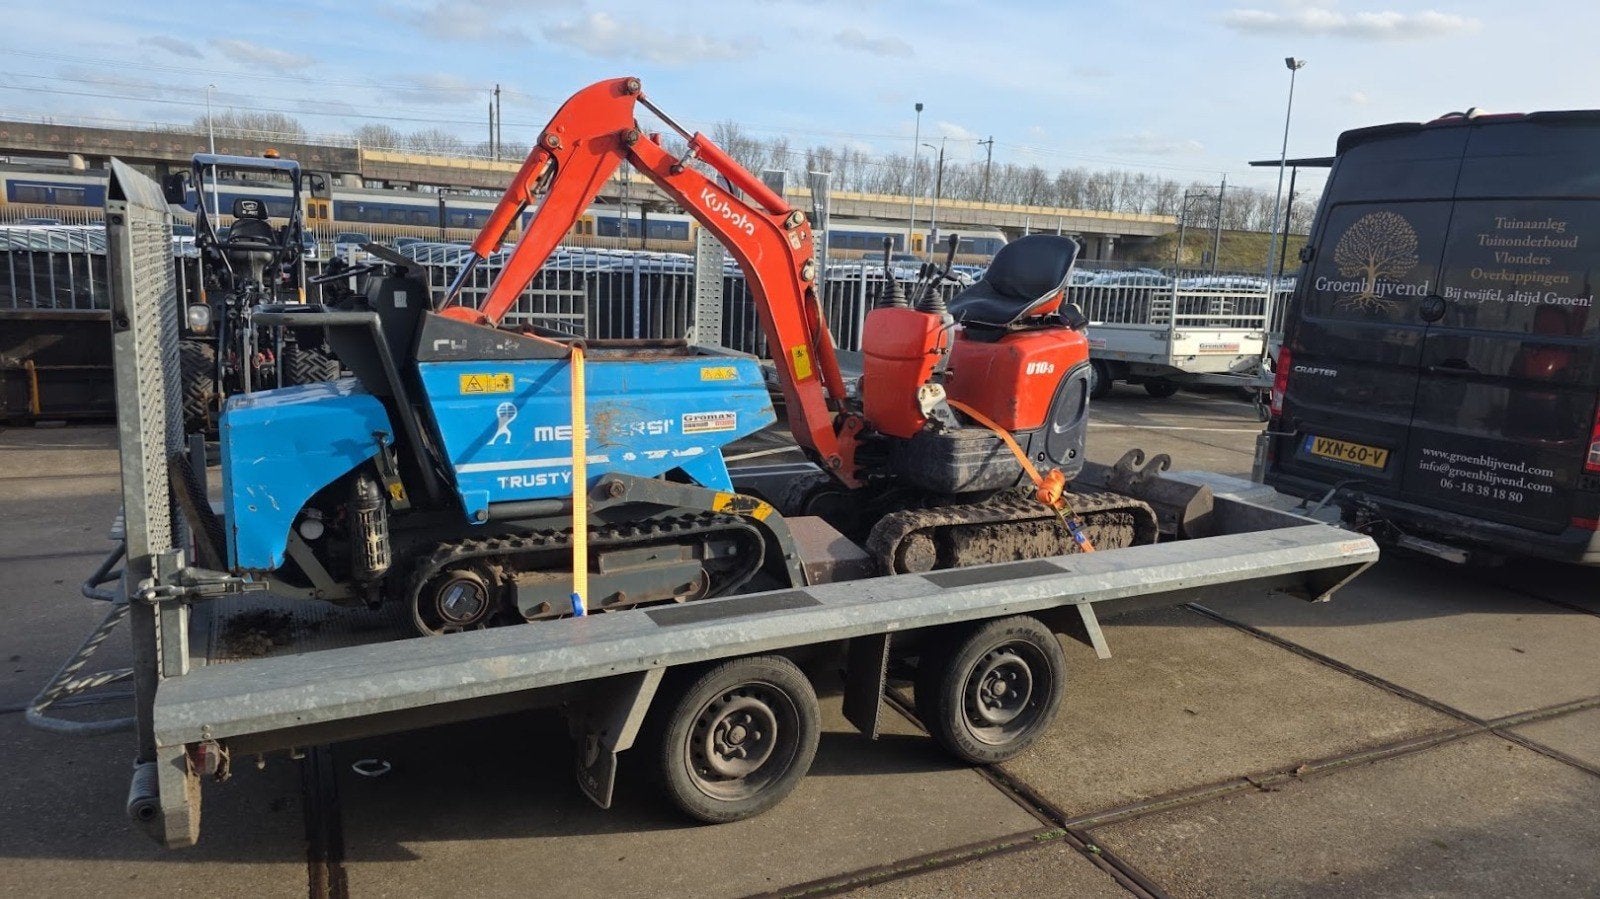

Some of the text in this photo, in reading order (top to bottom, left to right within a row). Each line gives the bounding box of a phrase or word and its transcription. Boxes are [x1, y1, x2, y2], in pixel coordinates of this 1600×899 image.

[700, 187, 756, 237] Kubota
[1494, 216, 1568, 234] Tuinaanleg
[1477, 233, 1579, 249] Tuinonderhoud
[1494, 251, 1552, 266] Vlonders
[1315, 276, 1430, 299] Groenblijvend
[1470, 267, 1570, 287] Overkappingen
[1443, 286, 1594, 308] Bij twijfel, altijd Groen!
[1026, 361, 1055, 376] U10-3
[1295, 365, 1338, 378] CRAFTER
[1316, 438, 1384, 465] VXN-60-V
[1422, 447, 1554, 478] www.groenblijvend.com
[497, 471, 572, 490] TRUSTY
[1419, 460, 1554, 493] info@groenblijvend.com
[1440, 478, 1454, 490] 06
[1475, 485, 1490, 497] 38
[1493, 488, 1506, 500] 18
[1508, 491, 1524, 503] 80
